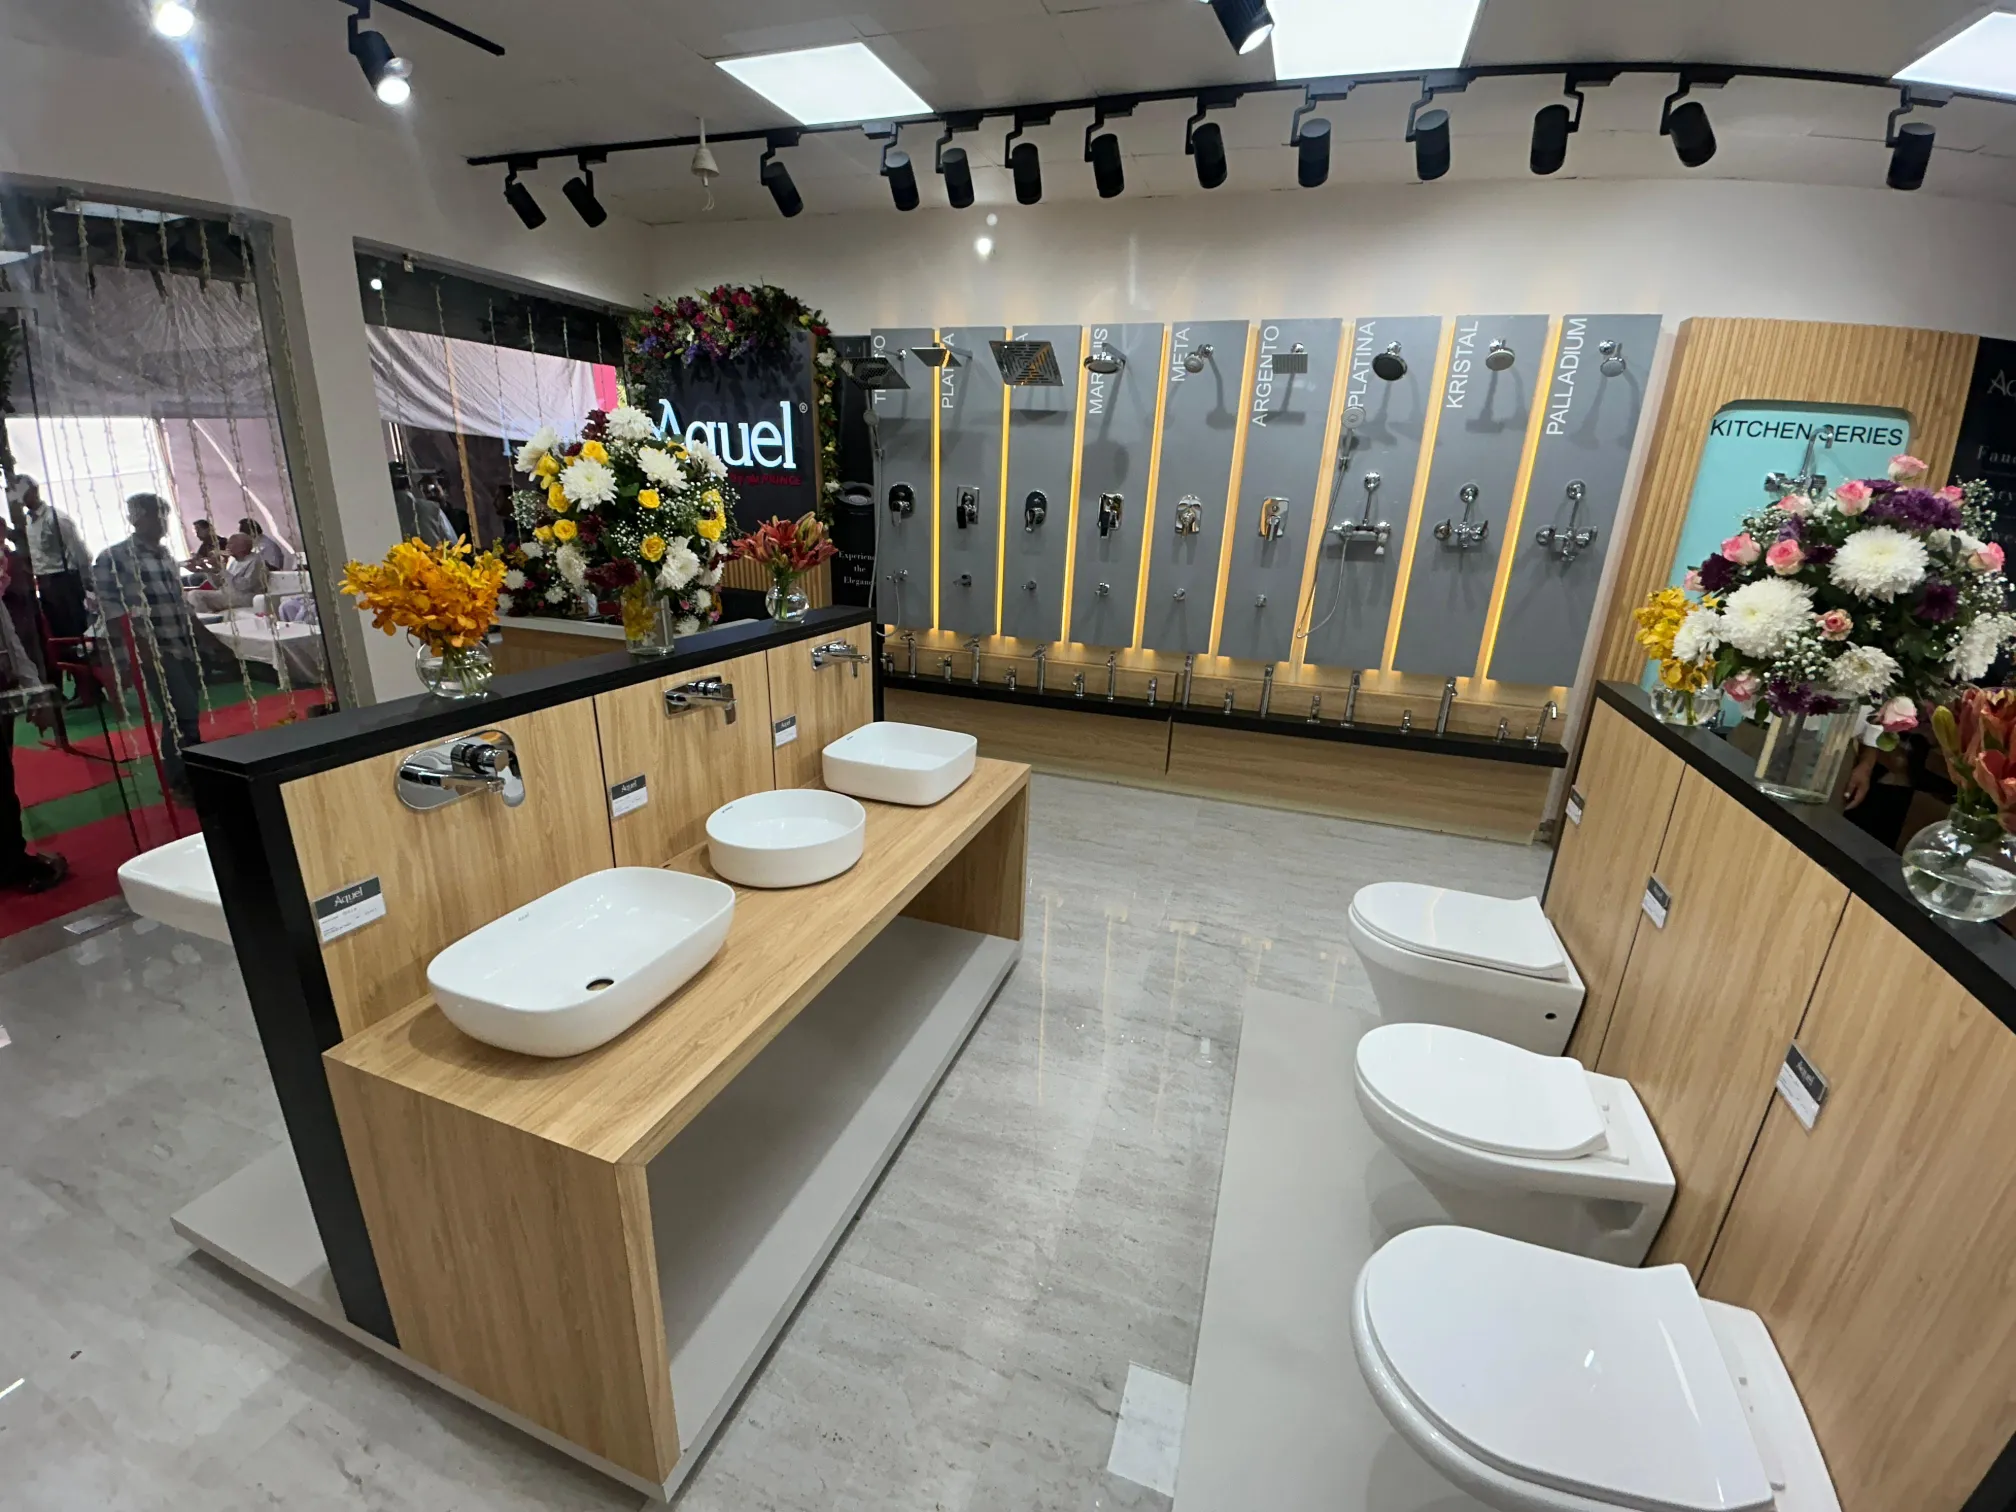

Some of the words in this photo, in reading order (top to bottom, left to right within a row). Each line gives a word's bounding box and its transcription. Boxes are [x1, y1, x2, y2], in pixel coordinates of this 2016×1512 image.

[941, 333, 955, 409] PLATA
[1089, 327, 1108, 414] MARIS
[1171, 327, 1190, 382] META
[1252, 325, 1280, 428] ARGENTO
[1347, 320, 1376, 408] PLATINA
[1446, 320, 1479, 408] KRISTAL
[1546, 317, 1588, 435] PALLADIUM
[1710, 419, 1813, 440] KITCHEN
[838, 550, 876, 561] Experienc
[843, 575, 872, 587] Eleganc
[333, 886, 364, 907] Aquel
